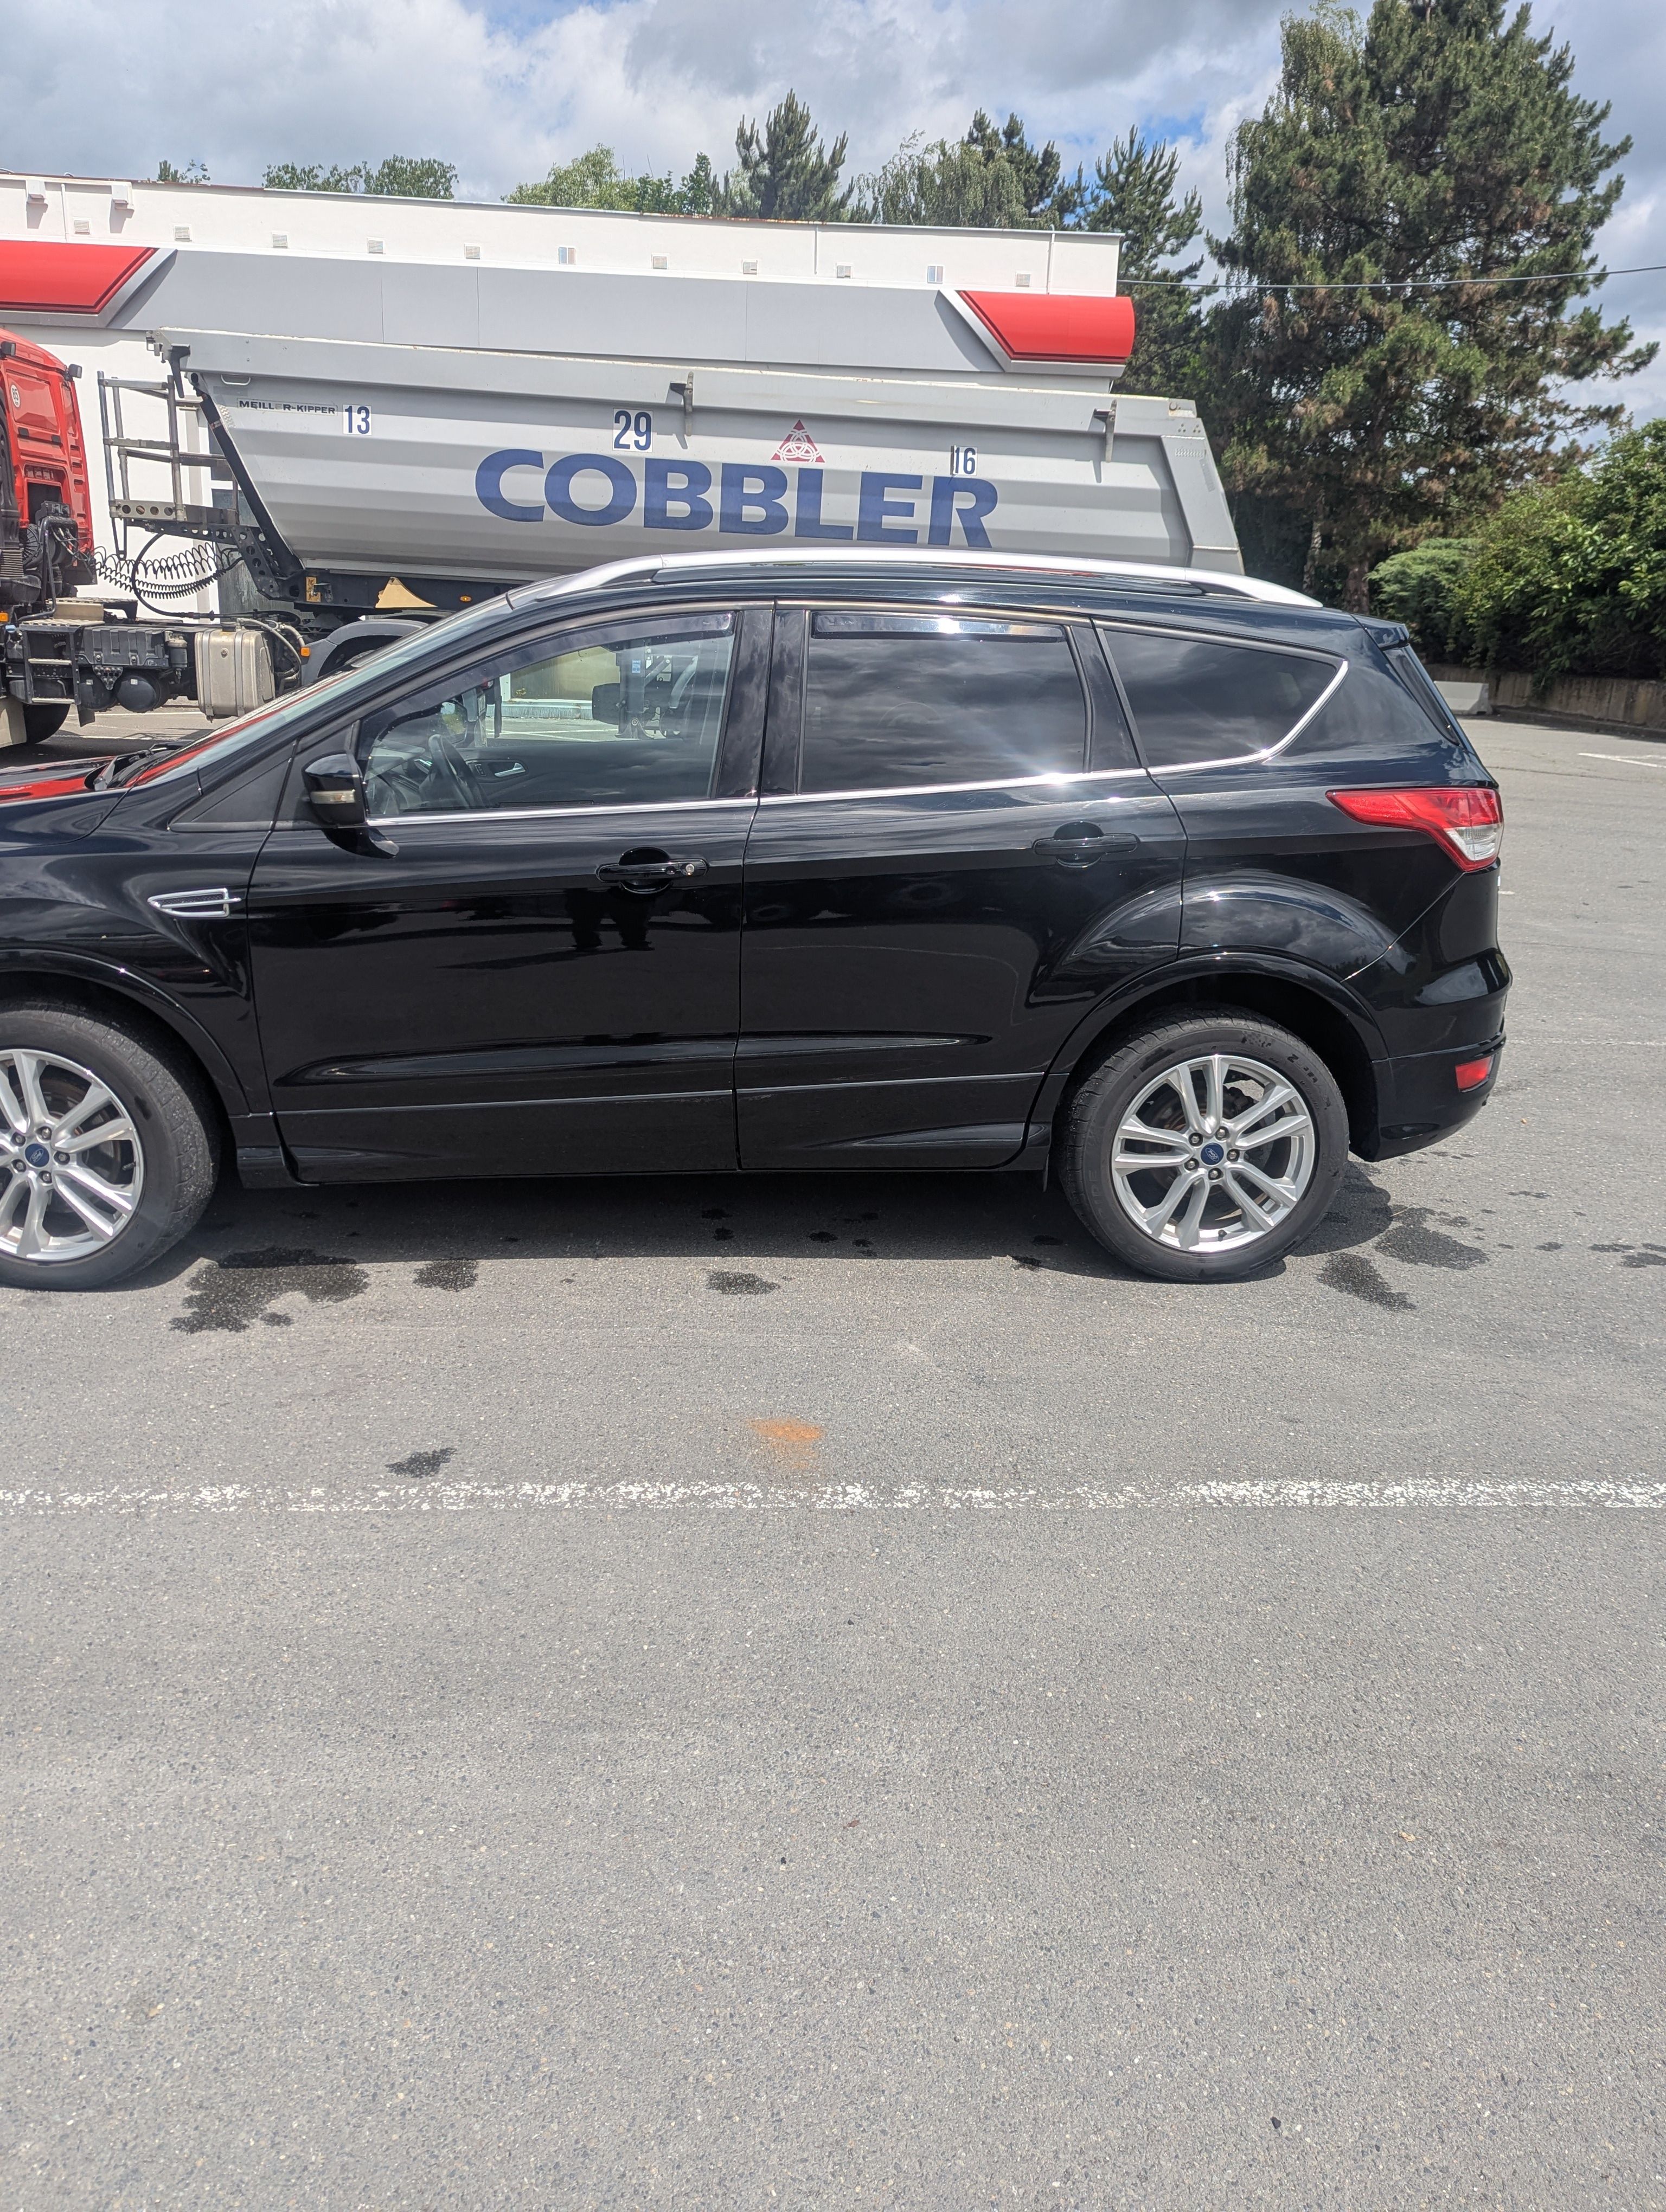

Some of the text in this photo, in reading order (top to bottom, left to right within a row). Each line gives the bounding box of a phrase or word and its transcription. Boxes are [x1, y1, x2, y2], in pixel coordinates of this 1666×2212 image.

[344, 405, 370, 434] 13
[614, 410, 652, 451] 29
[955, 447, 976, 474] 16
[476, 449, 998, 548] COBBLER
